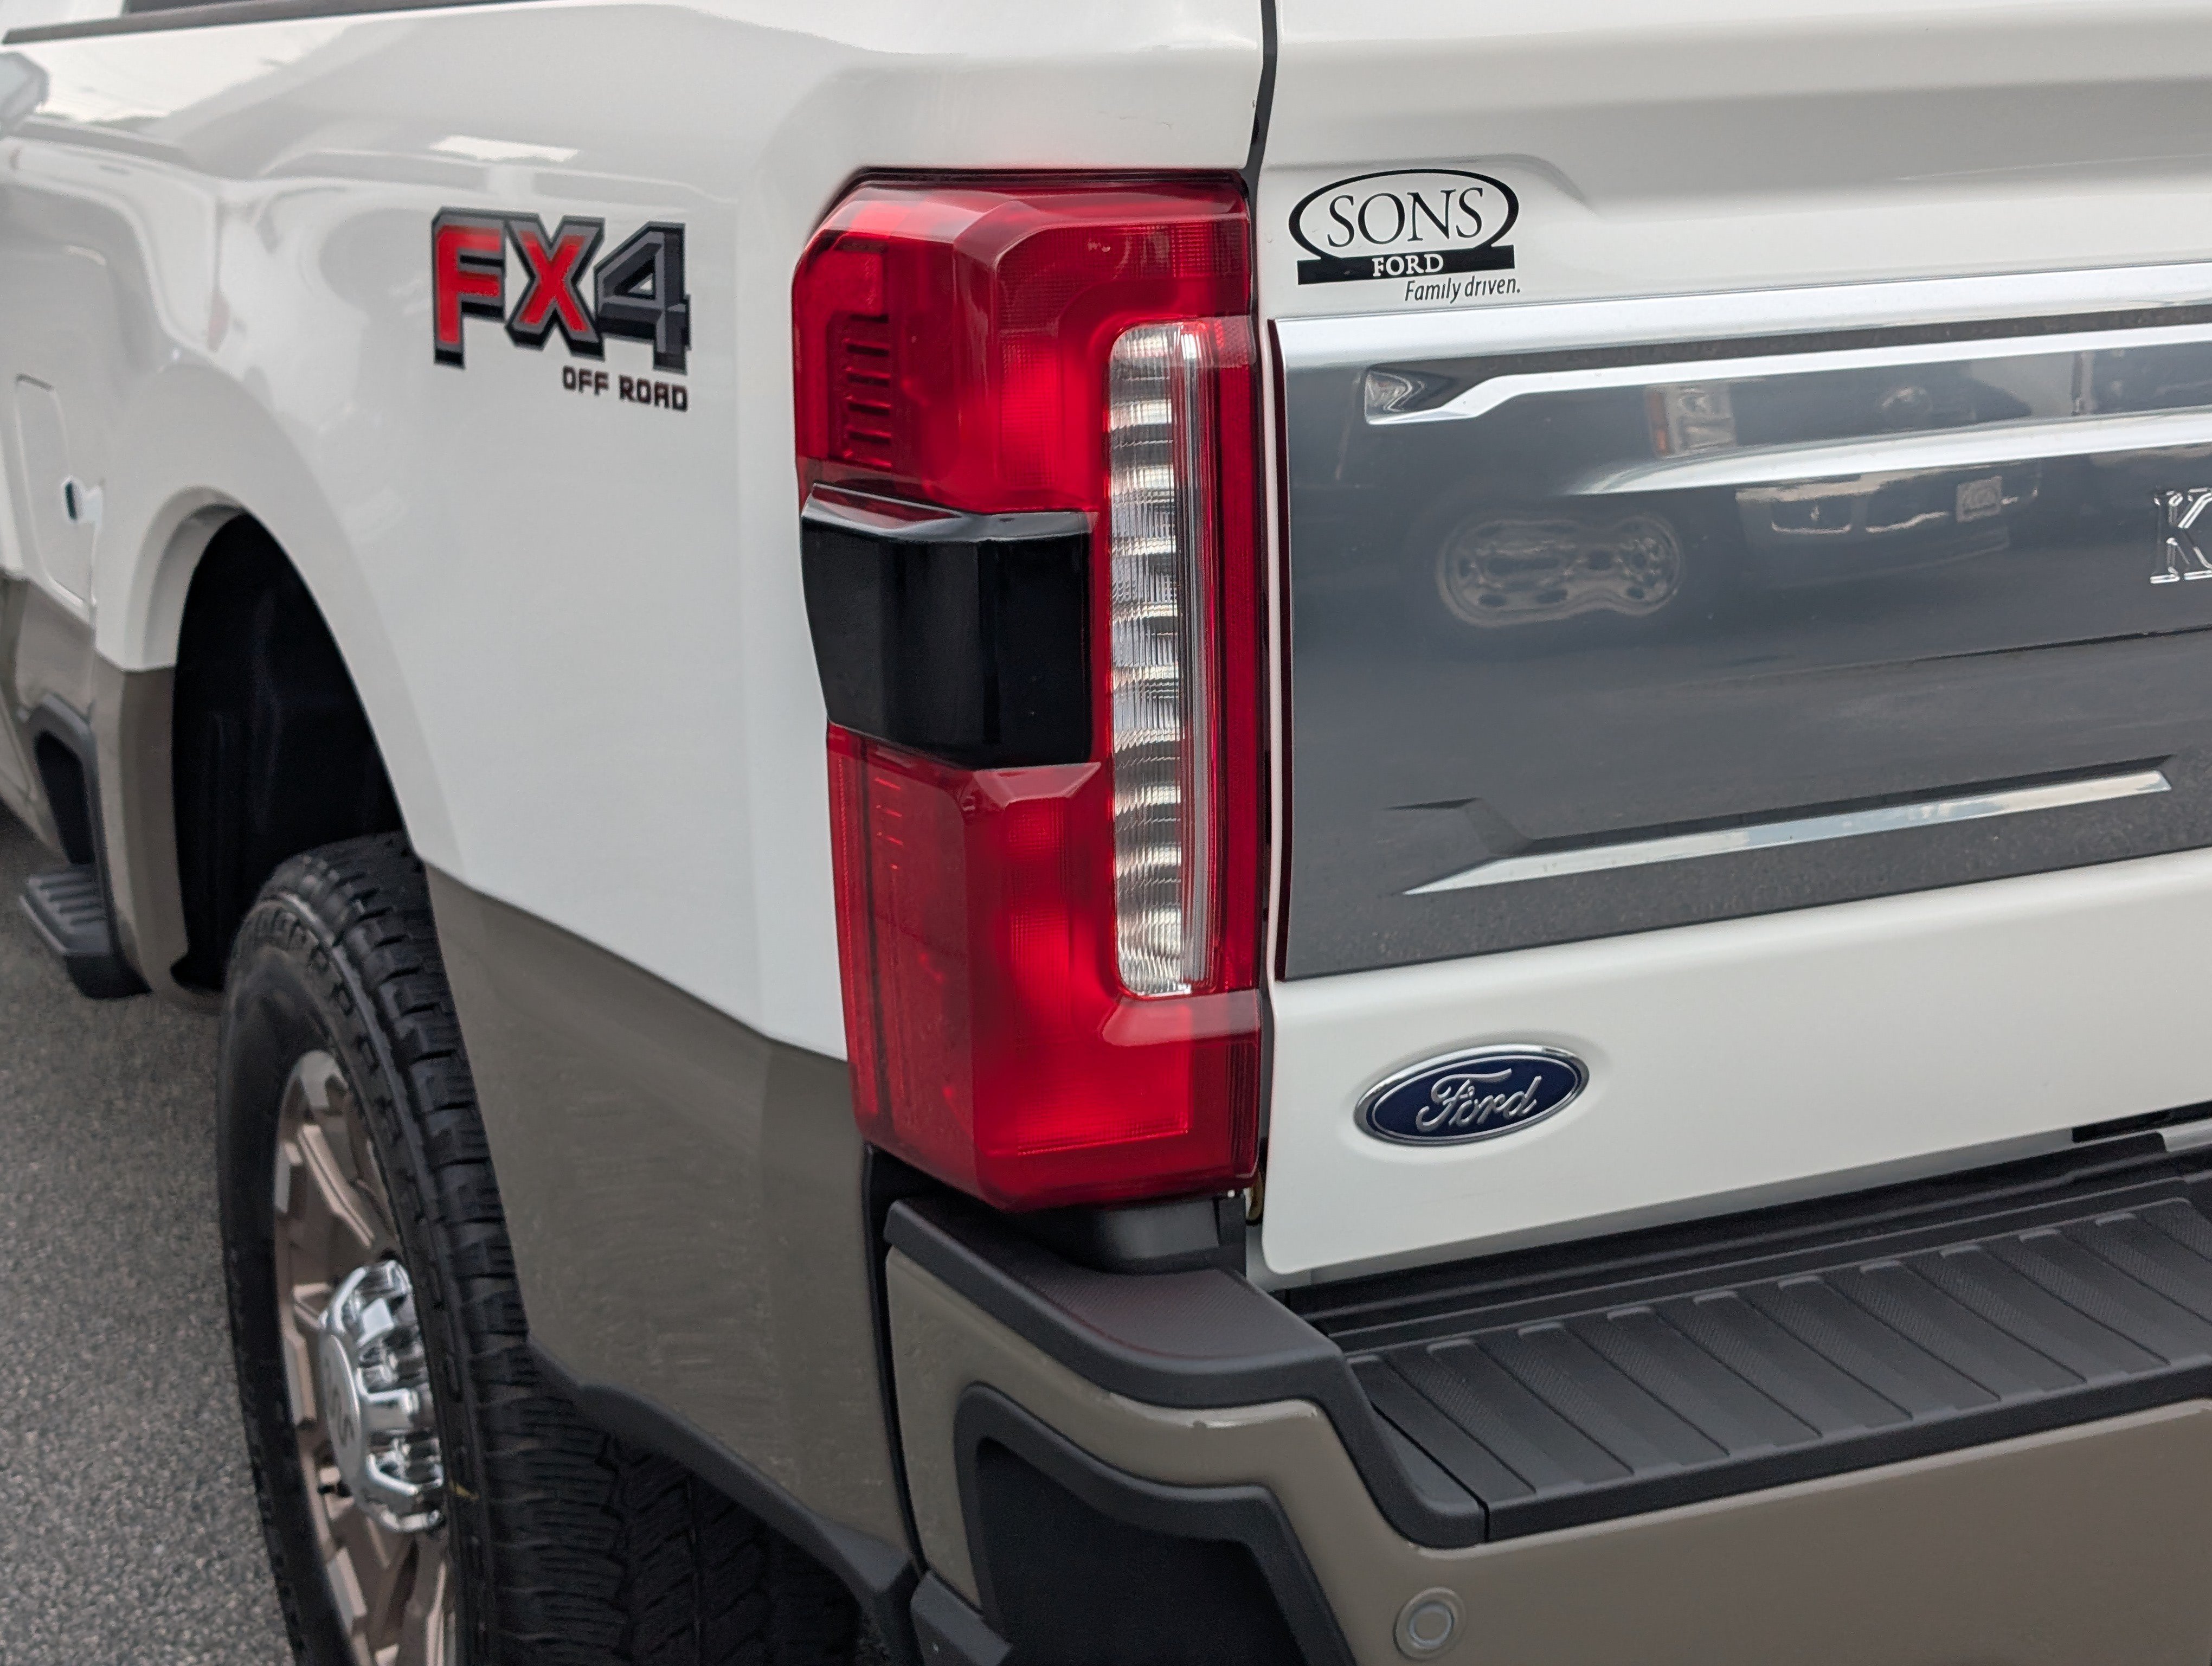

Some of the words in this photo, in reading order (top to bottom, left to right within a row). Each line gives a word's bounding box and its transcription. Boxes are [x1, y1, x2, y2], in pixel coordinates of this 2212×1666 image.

[1327, 187, 1483, 247] SONS
[432, 207, 692, 376] FX4
[1372, 253, 1444, 277] FORD
[1405, 277, 1462, 304] Family
[1464, 275, 1521, 297] driven.
[562, 365, 610, 397] OFF
[619, 374, 689, 413] ROAD
[1416, 1068, 1542, 1132] Ford
